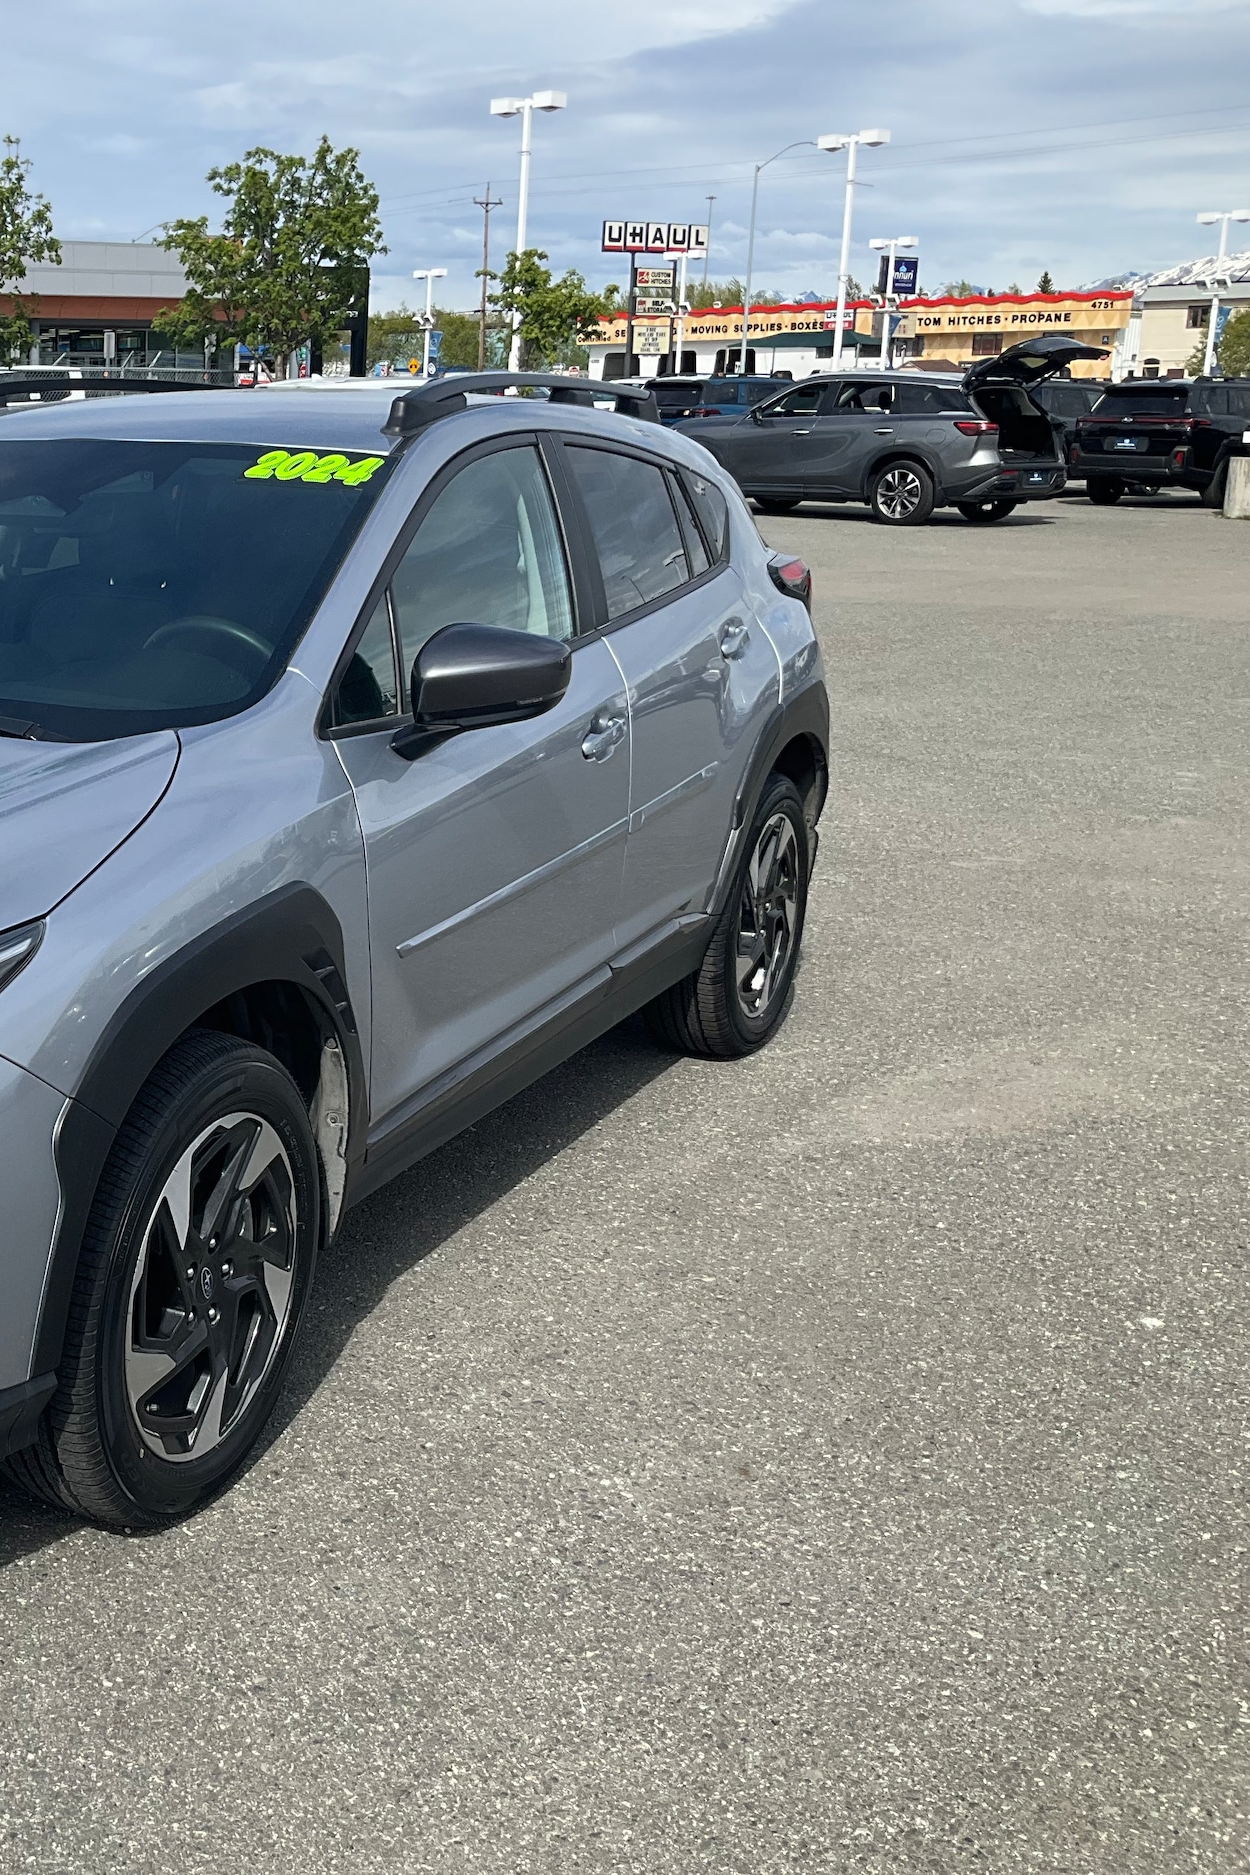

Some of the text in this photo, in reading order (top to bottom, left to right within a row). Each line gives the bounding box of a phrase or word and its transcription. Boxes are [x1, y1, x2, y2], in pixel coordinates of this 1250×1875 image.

[1091, 301, 1114, 309] 4751
[690, 322, 728, 334] MOVING
[790, 320, 824, 331] BOXES
[917, 316, 941, 327] TOM
[948, 315, 1001, 326] HITCHES
[1011, 312, 1071, 324] PROPANE
[243, 450, 385, 486] 2024
